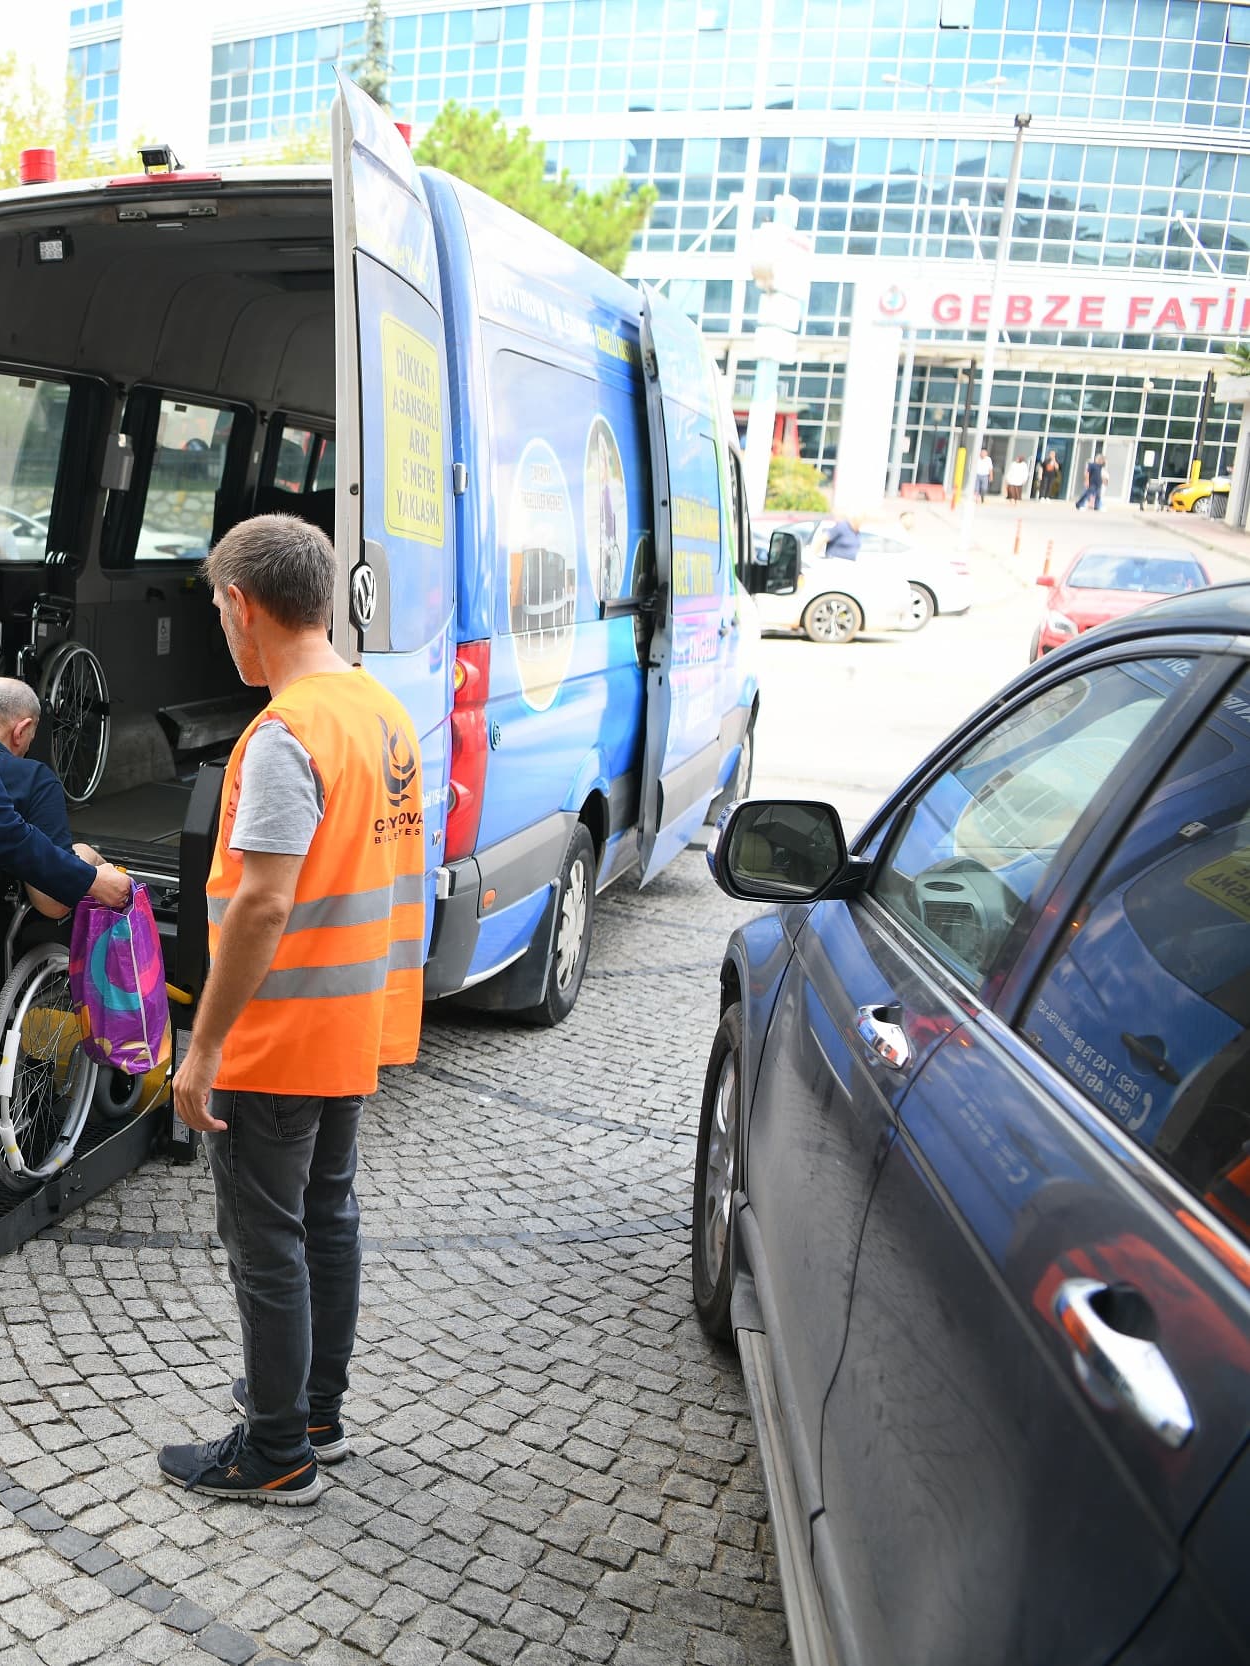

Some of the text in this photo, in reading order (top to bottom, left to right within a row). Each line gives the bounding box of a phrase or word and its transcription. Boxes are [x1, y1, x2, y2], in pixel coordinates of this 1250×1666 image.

[932, 287, 1250, 331] GEBZE FATİ
[397, 344, 431, 390] DİKKAT
[392, 390, 440, 433] ASANSÖRLÜ
[409, 429, 431, 459] ARAÇ
[402, 462, 437, 494] 5 METRE
[396, 489, 441, 529] YAKLAŞMA
